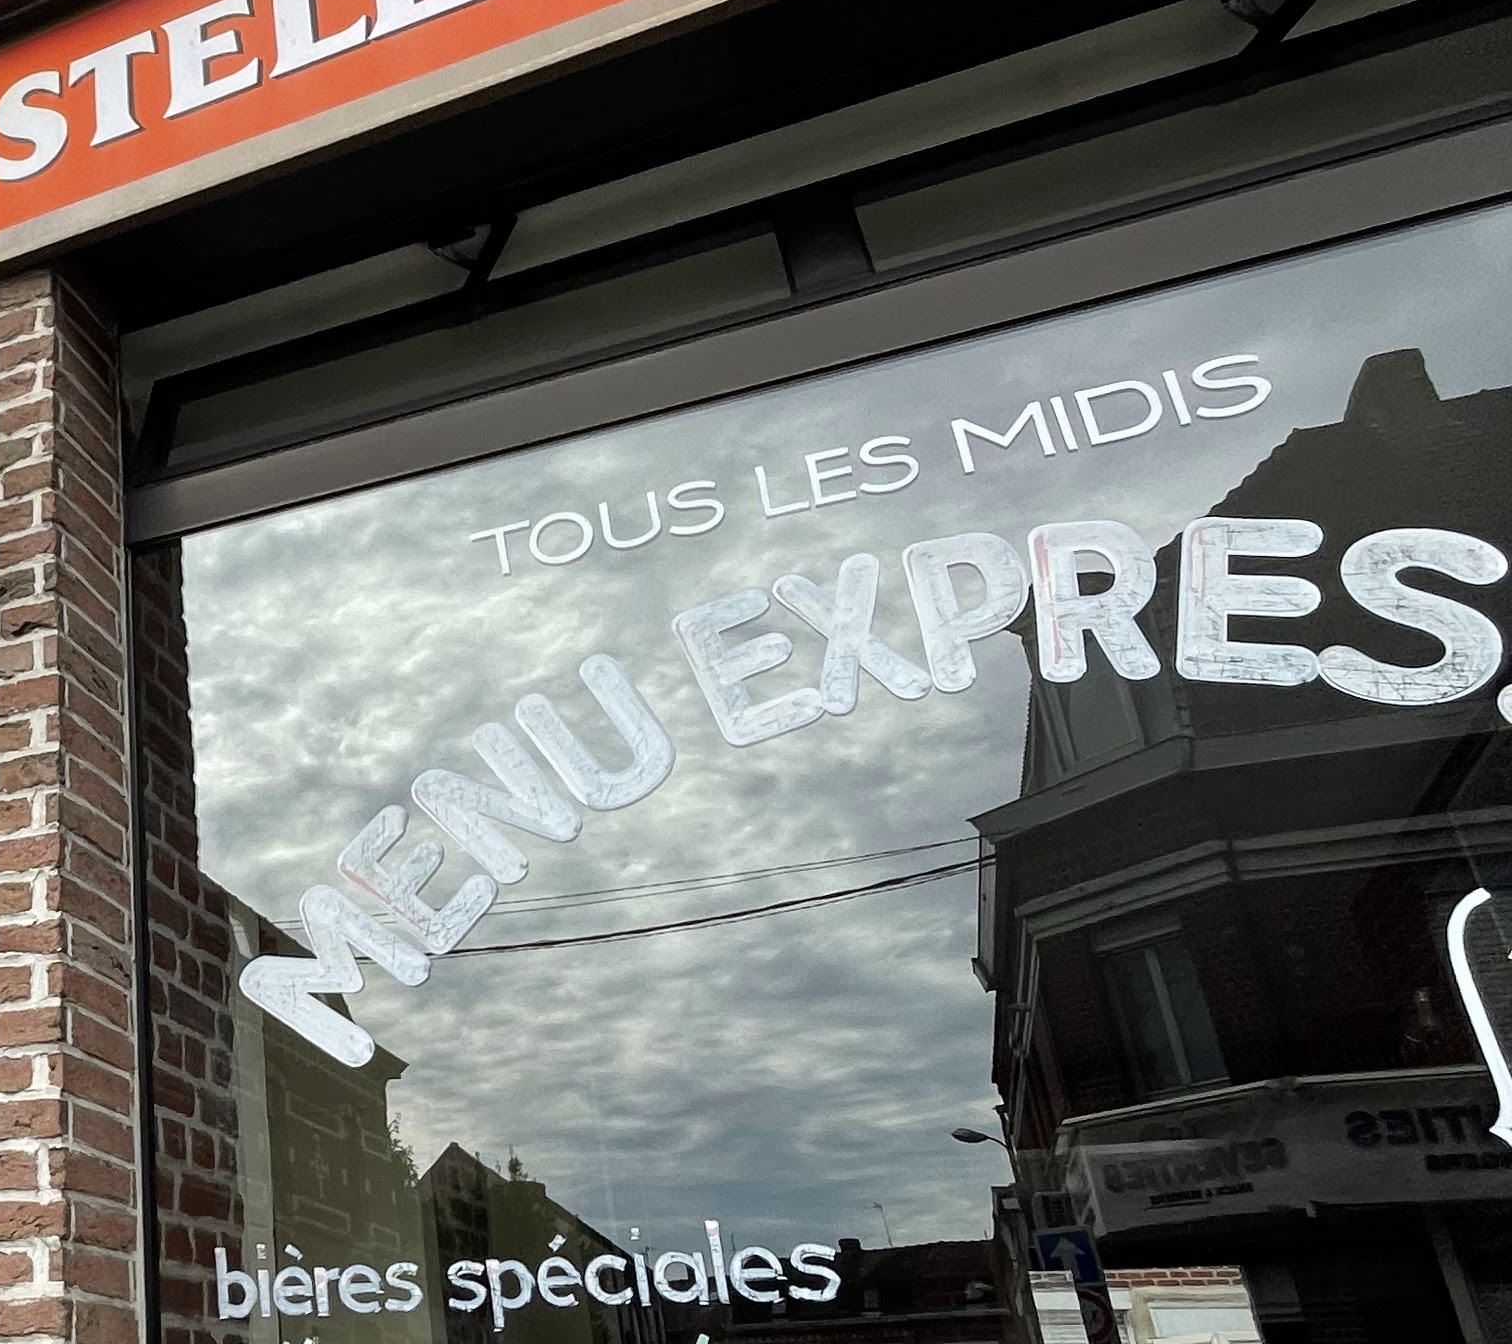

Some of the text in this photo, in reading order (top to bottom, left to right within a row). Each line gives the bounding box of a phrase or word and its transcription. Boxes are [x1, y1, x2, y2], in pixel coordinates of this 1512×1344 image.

[470, 354, 1273, 575] TOUS LES MIDIS
[238, 518, 1512, 1068] MENU EXPRES
[214, 1218, 841, 1332] bières spéciales
